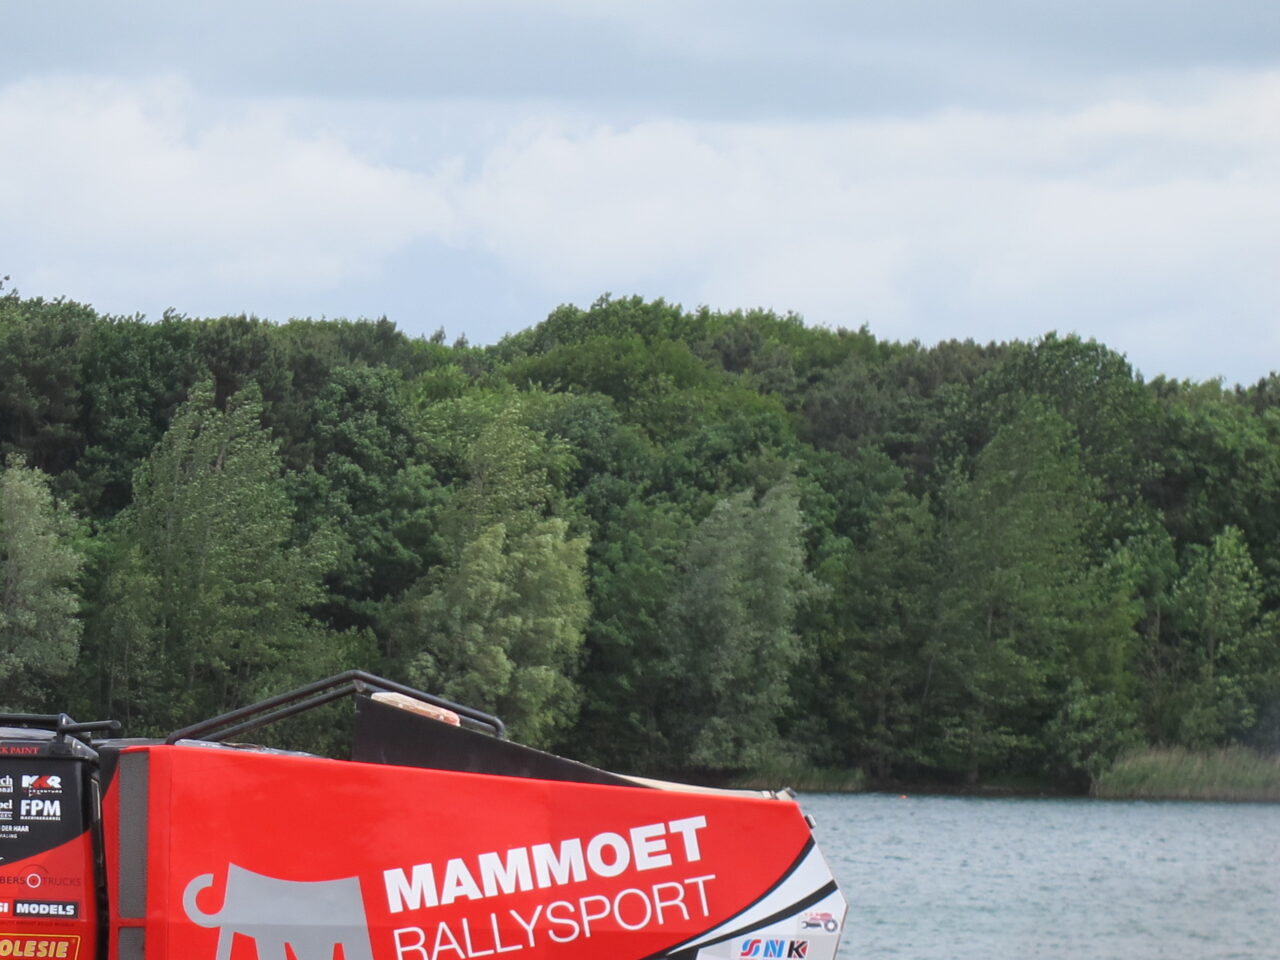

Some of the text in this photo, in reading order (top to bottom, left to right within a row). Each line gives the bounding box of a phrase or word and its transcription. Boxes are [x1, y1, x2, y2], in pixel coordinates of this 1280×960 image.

[10, 746, 39, 754] PAINT
[20, 799, 61, 816] FPM
[383, 815, 707, 914] MAMMOET
[42, 877, 81, 887] TRUCKS
[16, 903, 75, 915] MODELS
[740, 939, 808, 958] SNK
